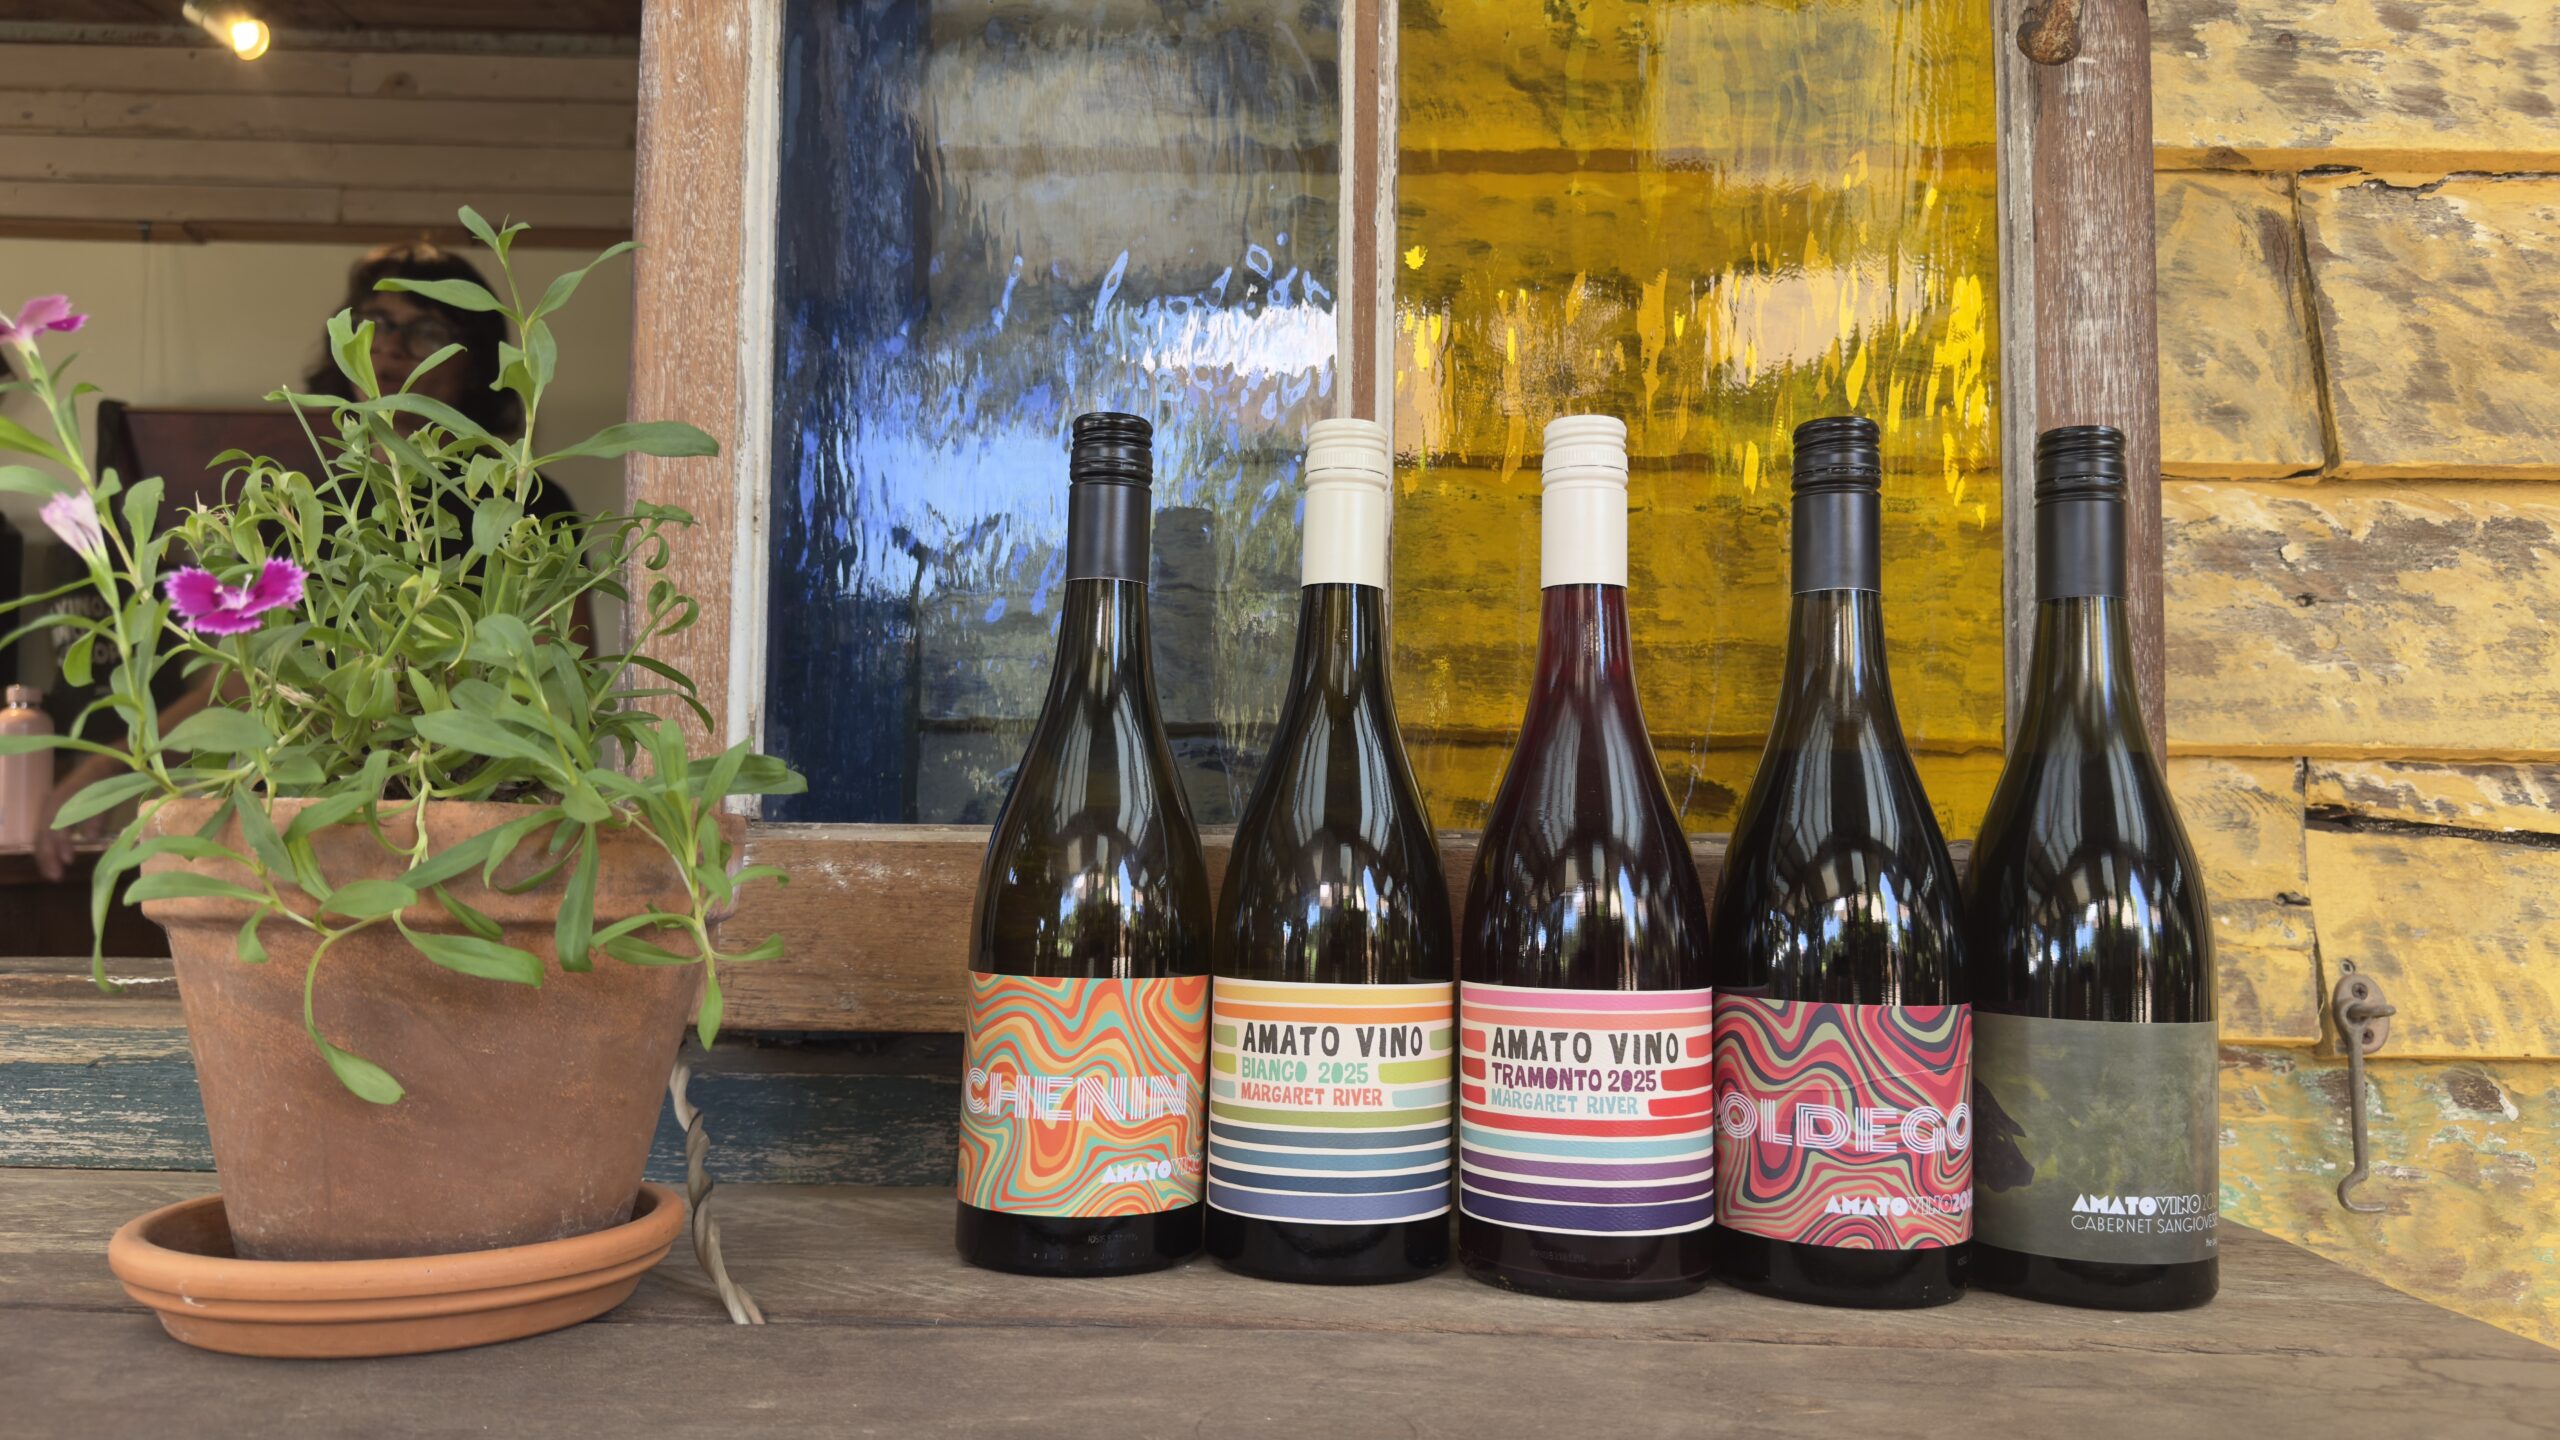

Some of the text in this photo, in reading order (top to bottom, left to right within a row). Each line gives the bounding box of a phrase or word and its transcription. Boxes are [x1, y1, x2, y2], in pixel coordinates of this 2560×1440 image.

[1242, 1022, 1423, 1058] AMATO VINO
[1491, 1027, 1679, 1065] AMATO VINO
[1241, 1056, 1369, 1085] BIANCO 2025
[1491, 1062, 1657, 1092] TRAMONTO 2025
[966, 1068, 1188, 1121] CHENIN
[1241, 1082, 1383, 1107] MARGARET RIVER
[1491, 1087, 1639, 1115] MARGARET RIVER
[1714, 1091, 1970, 1154] OLDEGO
[2071, 1214, 2152, 1234] CABERNET
